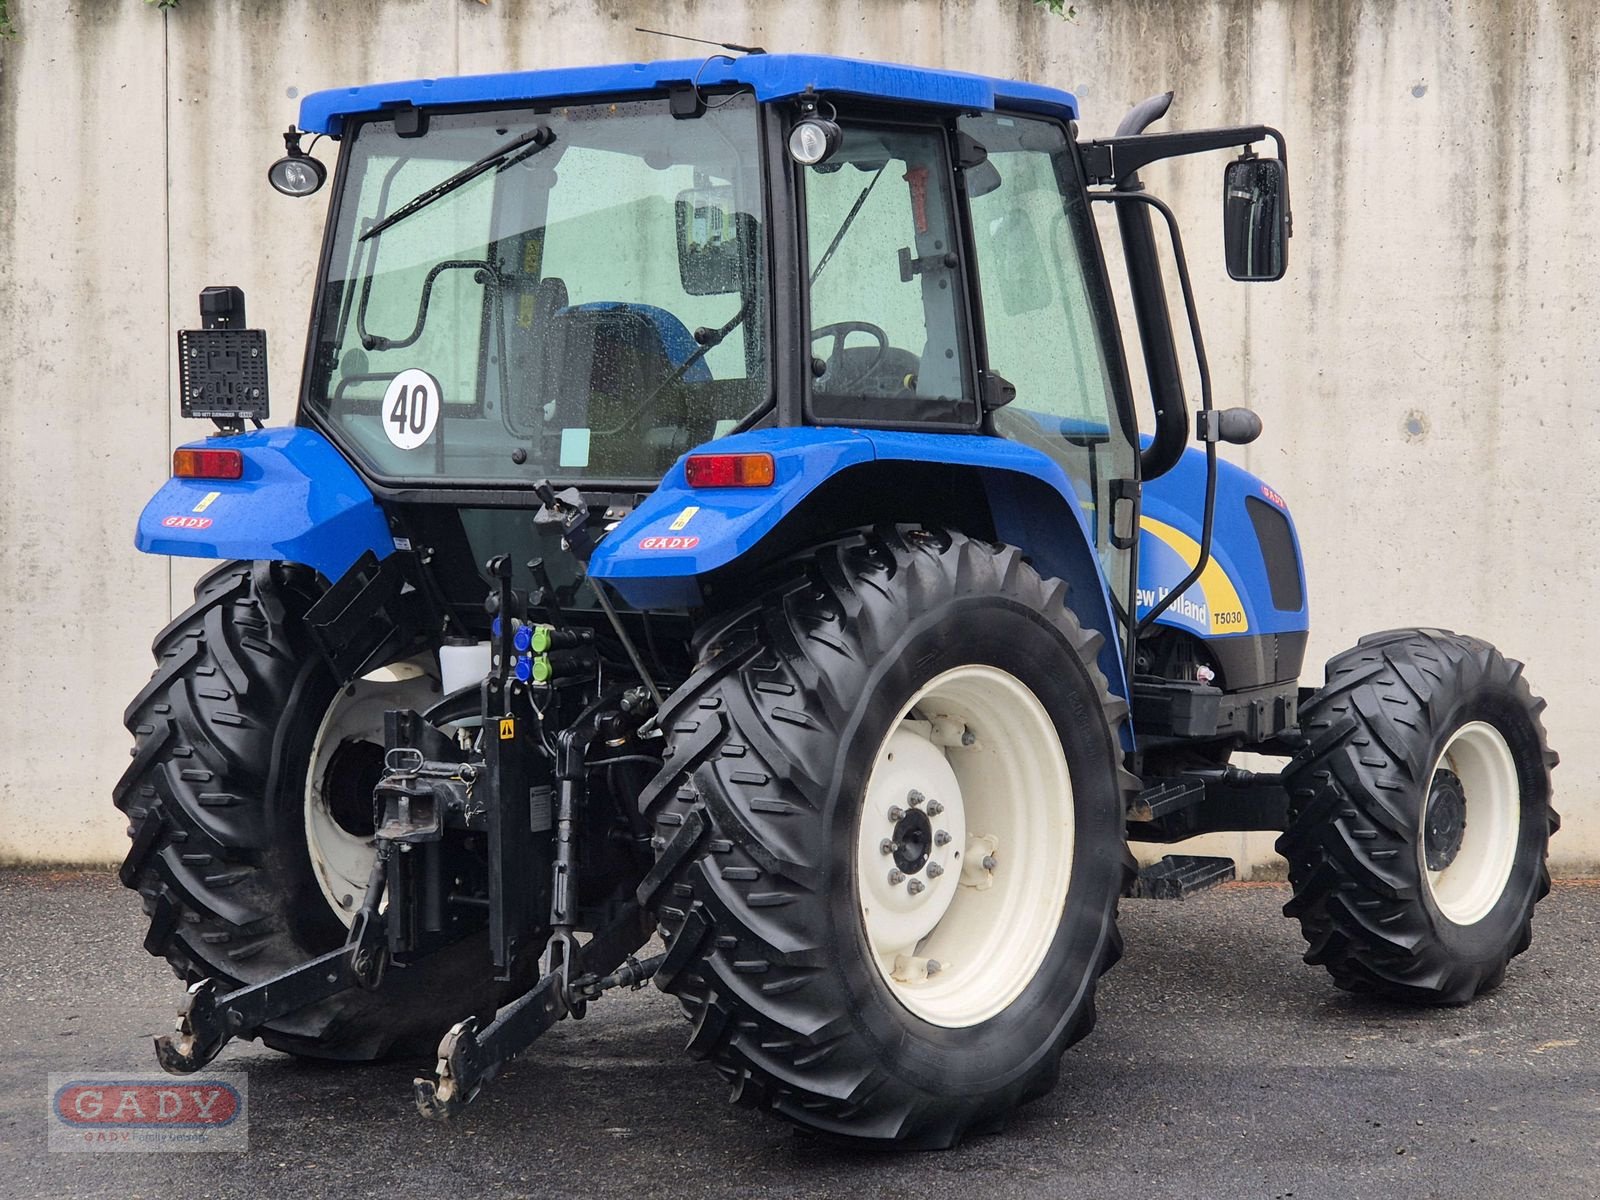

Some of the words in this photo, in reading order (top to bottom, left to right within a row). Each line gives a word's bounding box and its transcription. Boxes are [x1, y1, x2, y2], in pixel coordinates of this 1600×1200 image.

[390, 384, 428, 434] 40
[165, 516, 212, 528] GADY
[643, 537, 696, 549] GADY
[1136, 588, 1155, 607] ew
[1214, 611, 1242, 624] T5030
